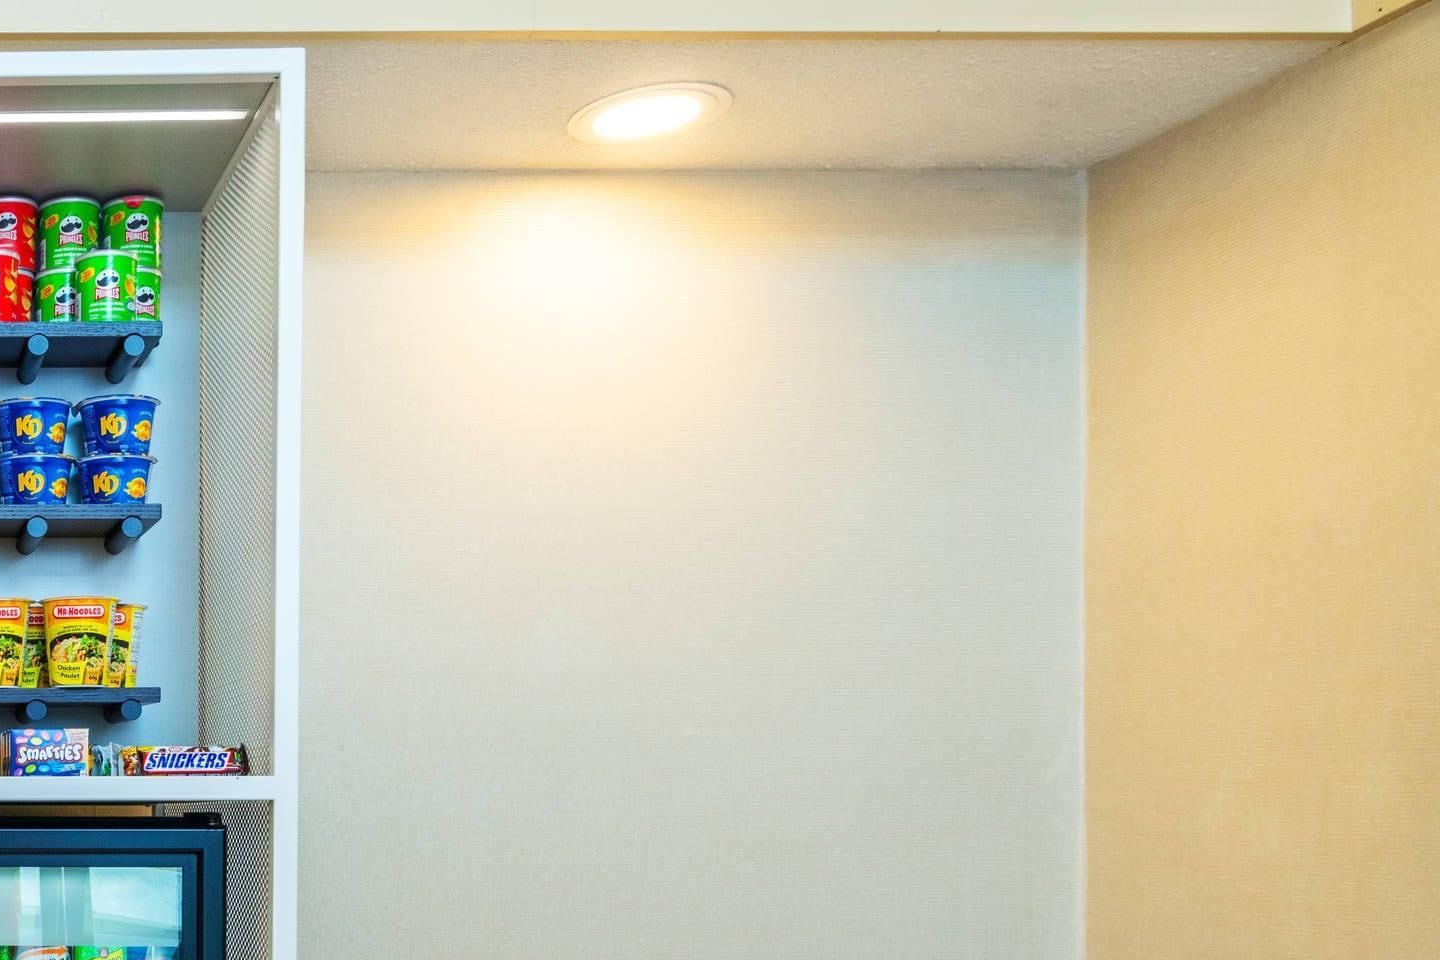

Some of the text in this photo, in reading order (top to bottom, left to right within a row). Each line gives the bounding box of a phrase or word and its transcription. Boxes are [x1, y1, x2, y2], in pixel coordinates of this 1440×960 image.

[16, 414, 43, 440] KD
[100, 412, 127, 439] KD
[18, 469, 45, 496] KD
[93, 470, 119, 497] KD
[68, 607, 101, 615] NOODLES
[57, 664, 80, 672] Chicken
[60, 672, 80, 680] Poulet
[144, 751, 230, 771] SNICKERS
